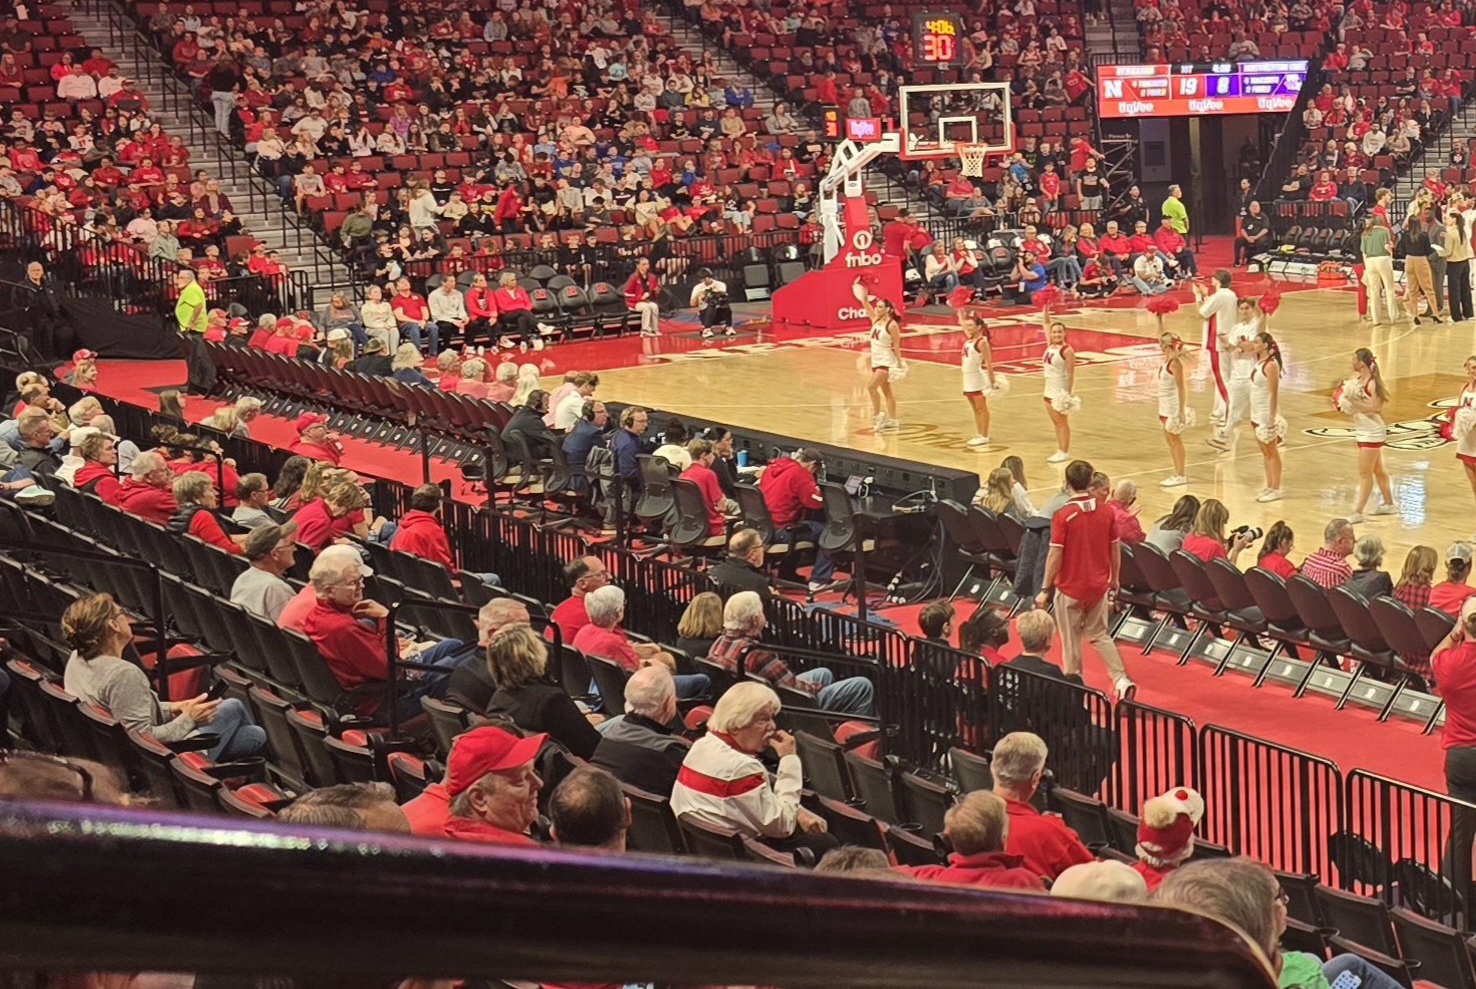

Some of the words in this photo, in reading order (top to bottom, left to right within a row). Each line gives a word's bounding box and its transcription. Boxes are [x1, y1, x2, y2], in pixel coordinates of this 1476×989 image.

[926, 20, 955, 35] 4:06
[923, 34, 954, 60] 30
[1104, 79, 1123, 99] N
[1179, 78, 1198, 95] 19
[845, 251, 882, 268] fnbo
[838, 307, 867, 321] Cha
